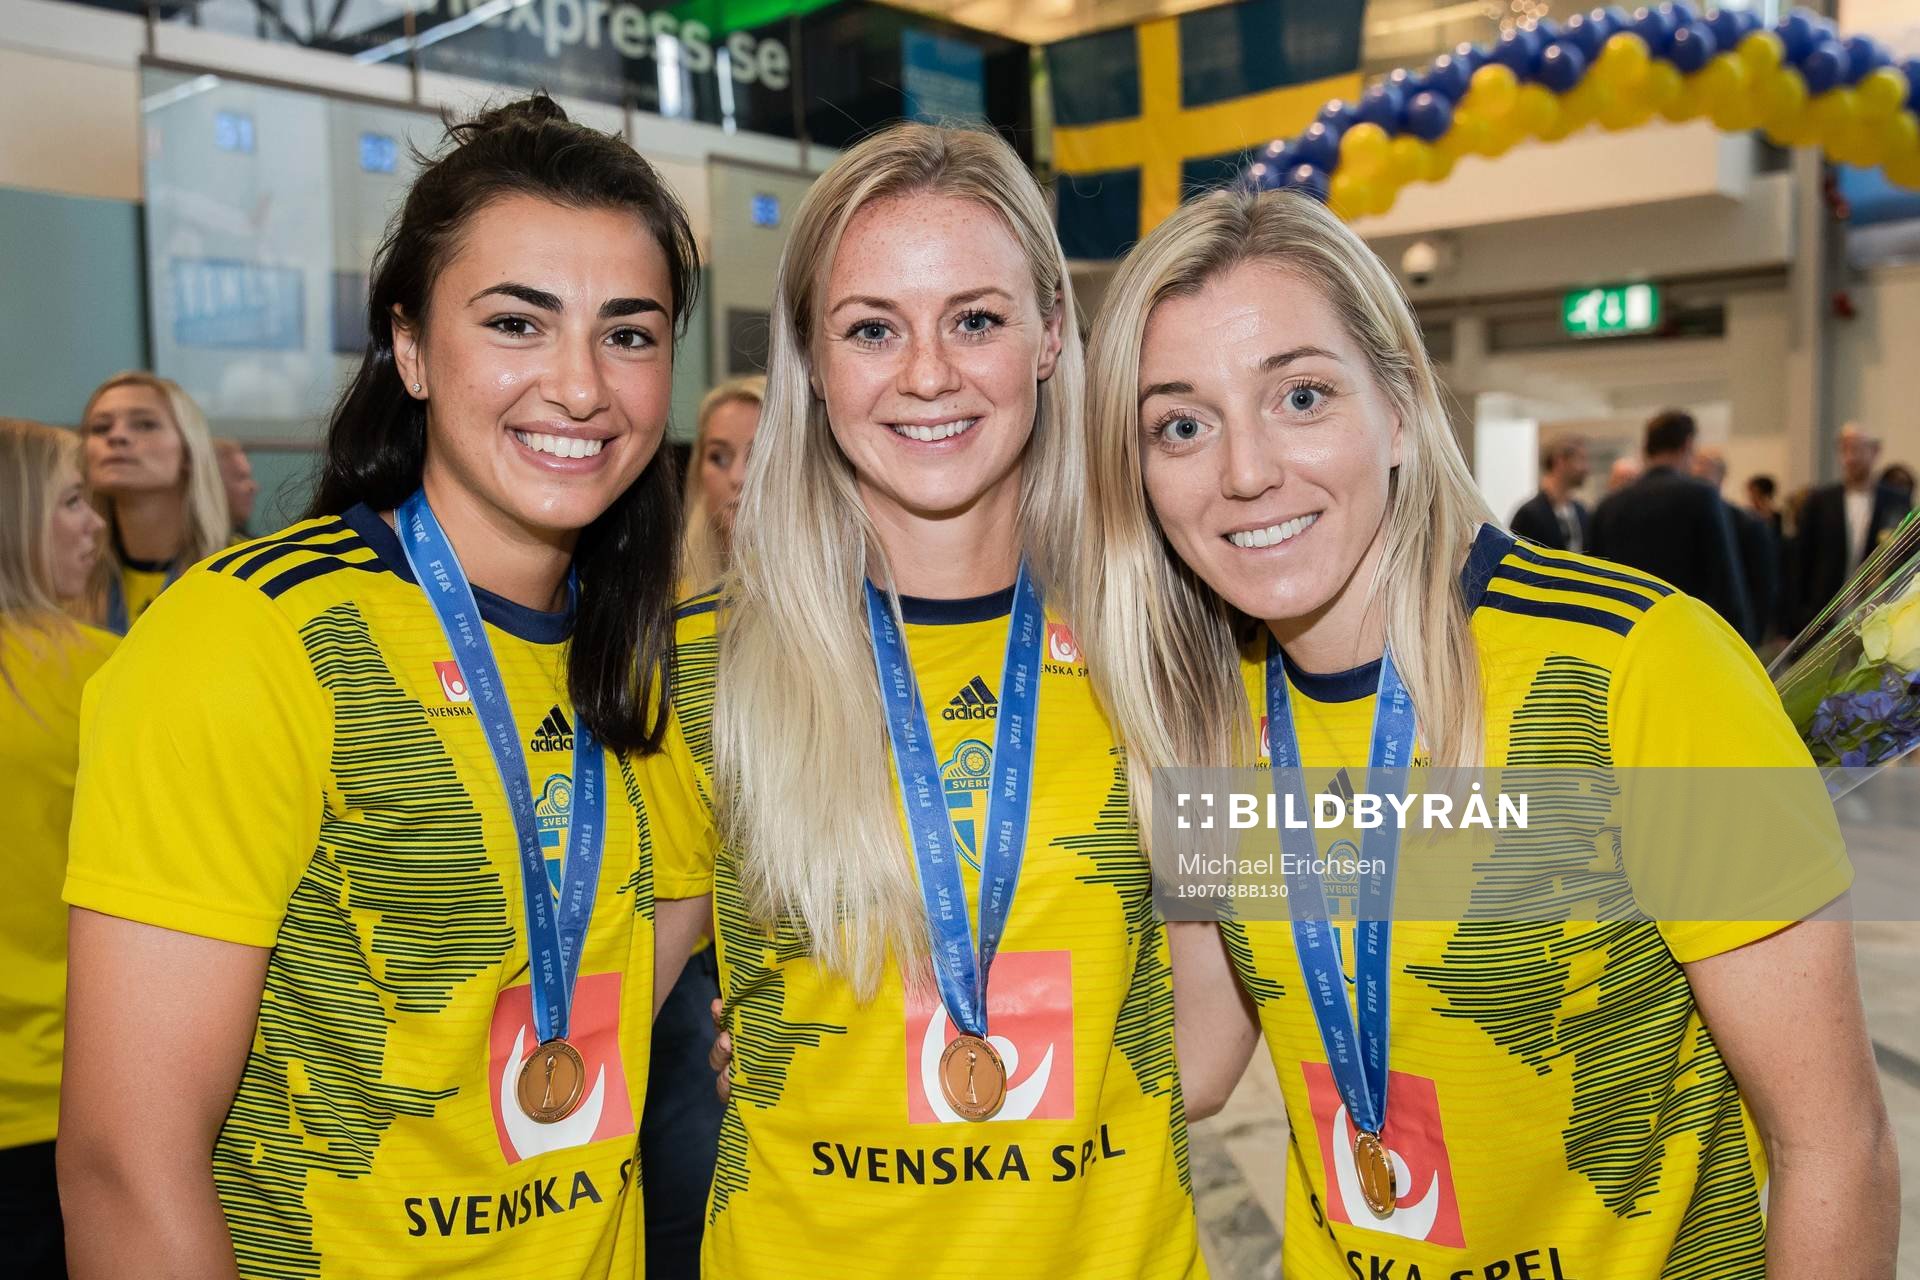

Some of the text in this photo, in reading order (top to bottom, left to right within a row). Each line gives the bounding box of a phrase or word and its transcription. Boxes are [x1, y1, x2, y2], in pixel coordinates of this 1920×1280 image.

[1021, 613, 1033, 642] FIFA
[893, 666, 908, 698] FIFA
[1014, 664, 1027, 694] FIFA
[1041, 664, 1074, 676] ENSKA
[427, 706, 474, 718] SVENSKA
[942, 705, 998, 720] adida
[530, 738, 574, 752] adida
[1010, 715, 1022, 745] FIFA
[430, 560, 452, 594] FIFA
[455, 613, 475, 646] FIFA
[542, 950, 554, 984] FIFA
[952, 779, 990, 789] SVERI
[1005, 767, 1017, 798] FIFA
[915, 776, 931, 808] FIFA
[542, 816, 569, 827] SVER
[999, 820, 1012, 853] FIFA
[579, 824, 592, 858] FIFA
[927, 830, 943, 864] FIFA
[570, 881, 584, 914] FIFA
[938, 887, 953, 921] FIFA
[1323, 884, 1358, 894] SVERIG
[1367, 921, 1378, 955] FIFA
[1317, 972, 1334, 1006] FIFA
[1367, 981, 1377, 1013] FIFA
[1334, 1030, 1348, 1064] FIFA
[812, 1124, 1126, 1185] SVENSKA SPL
[404, 1171, 603, 1237] SVENSKA
